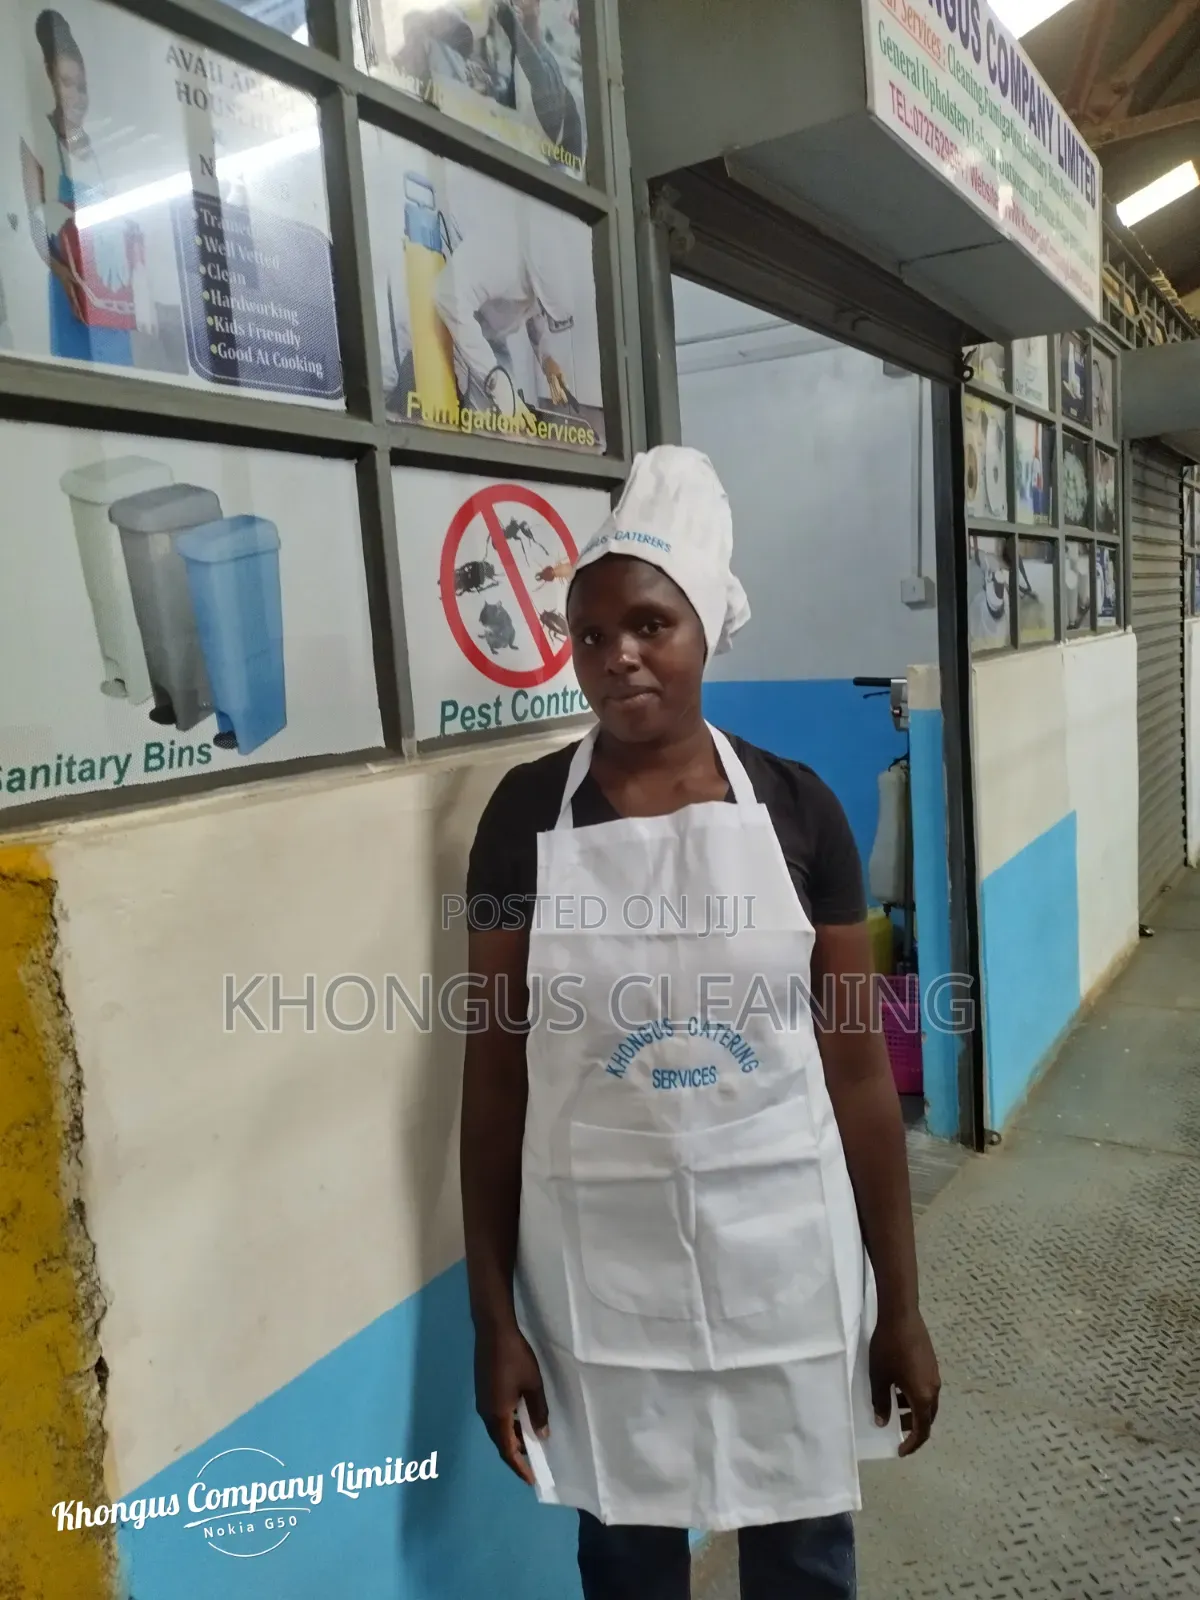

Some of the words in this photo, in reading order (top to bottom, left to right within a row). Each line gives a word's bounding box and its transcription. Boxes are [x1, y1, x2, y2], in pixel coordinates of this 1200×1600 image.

[878, 20, 921, 91] General
[986, 19, 1054, 155] COMPANY
[1057, 113, 1096, 211] LIMITED
[203, 235, 237, 254] Well
[238, 243, 280, 269] Vetted
[206, 263, 246, 285] Clean
[210, 290, 299, 325] Hardworking
[214, 315, 245, 335] Kids
[249, 323, 300, 349] Friendly
[217, 343, 252, 362] Good
[257, 350, 270, 367] At
[272, 353, 323, 379] Cooking
[407, 391, 520, 434] Fumigation
[526, 411, 595, 446] Services
[614, 530, 672, 553] CATERERS
[440, 694, 502, 737] Pest
[511, 684, 590, 722] Contro
[144, 740, 212, 773] Bins
[606, 1017, 675, 1079] KHONGUS
[688, 1016, 759, 1073] CATERING
[652, 1065, 717, 1089] SERVICES
